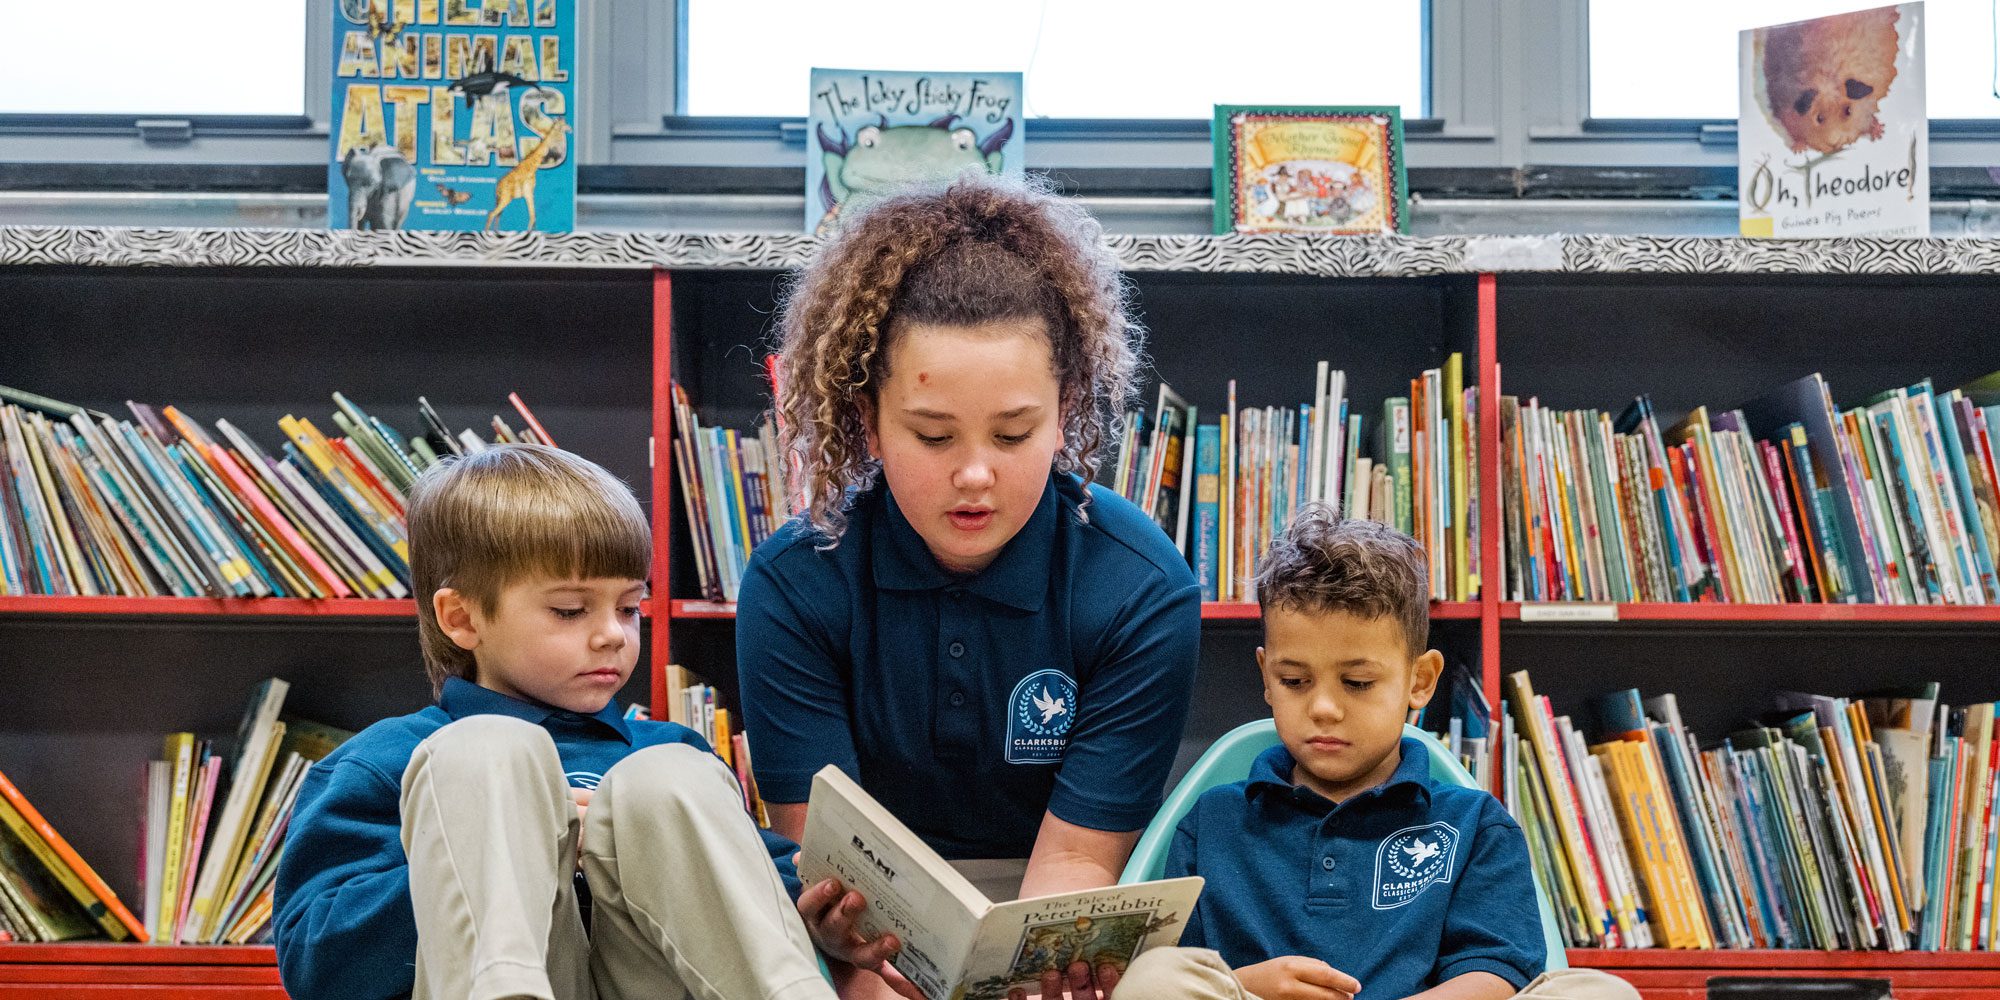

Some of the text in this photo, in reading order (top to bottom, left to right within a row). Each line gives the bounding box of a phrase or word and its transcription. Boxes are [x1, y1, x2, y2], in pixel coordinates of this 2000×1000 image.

[337, 31, 569, 81] ANIMAL
[817, 75, 1011, 127] The Icky Sticky Frog
[336, 84, 567, 169] ATLAS
[1746, 132, 1917, 214] Oh, Theodore!
[1781, 206, 1882, 230] Guinea Pig Poems
[1014, 738, 1067, 746] CLARKSBU
[851, 834, 896, 881] BAM!
[1023, 897, 1164, 924] Peter Rabbit
[1044, 892, 1125, 911] The Tale of
